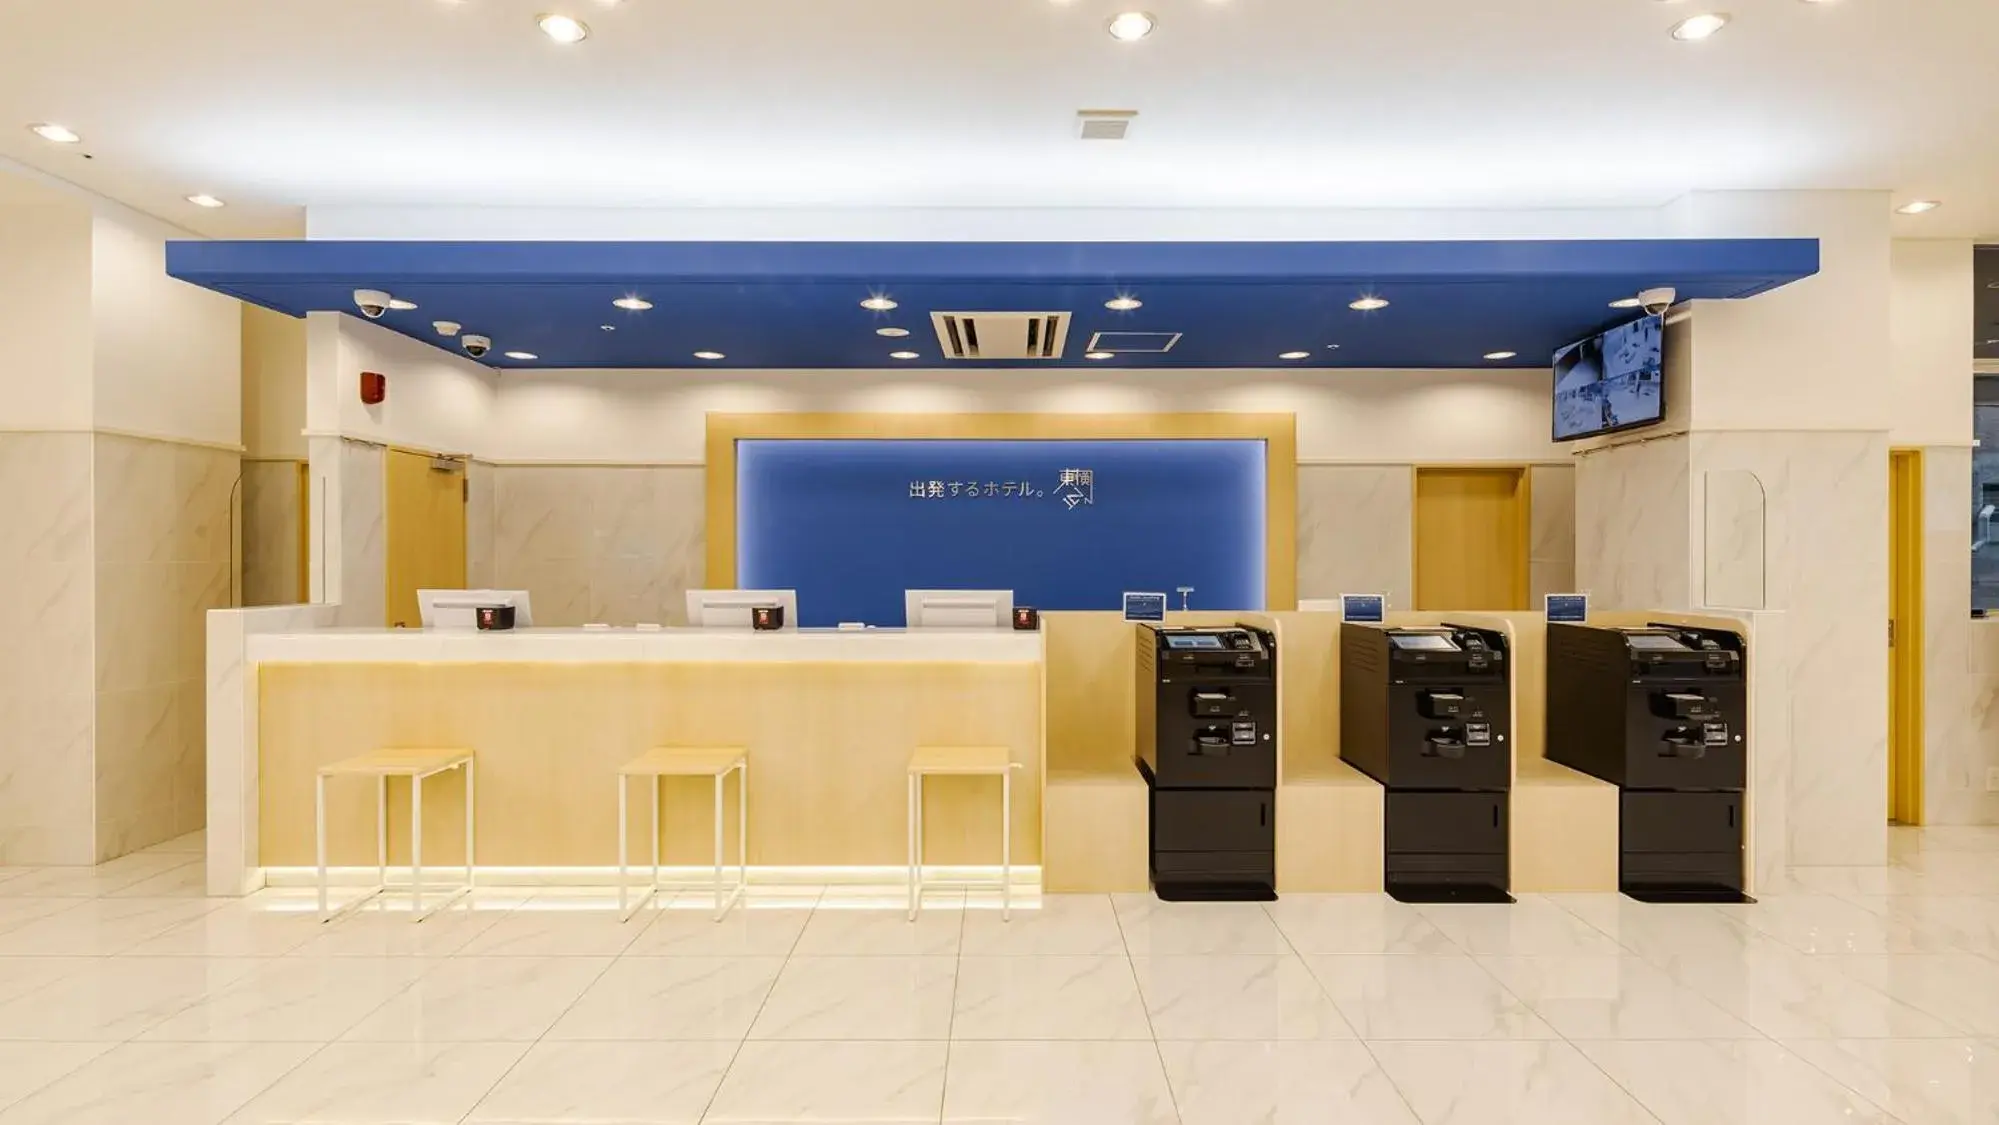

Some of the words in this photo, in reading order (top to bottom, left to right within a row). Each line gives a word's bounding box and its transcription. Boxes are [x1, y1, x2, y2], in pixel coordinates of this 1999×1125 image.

[909, 480, 1044, 498] 出発するホテル。
